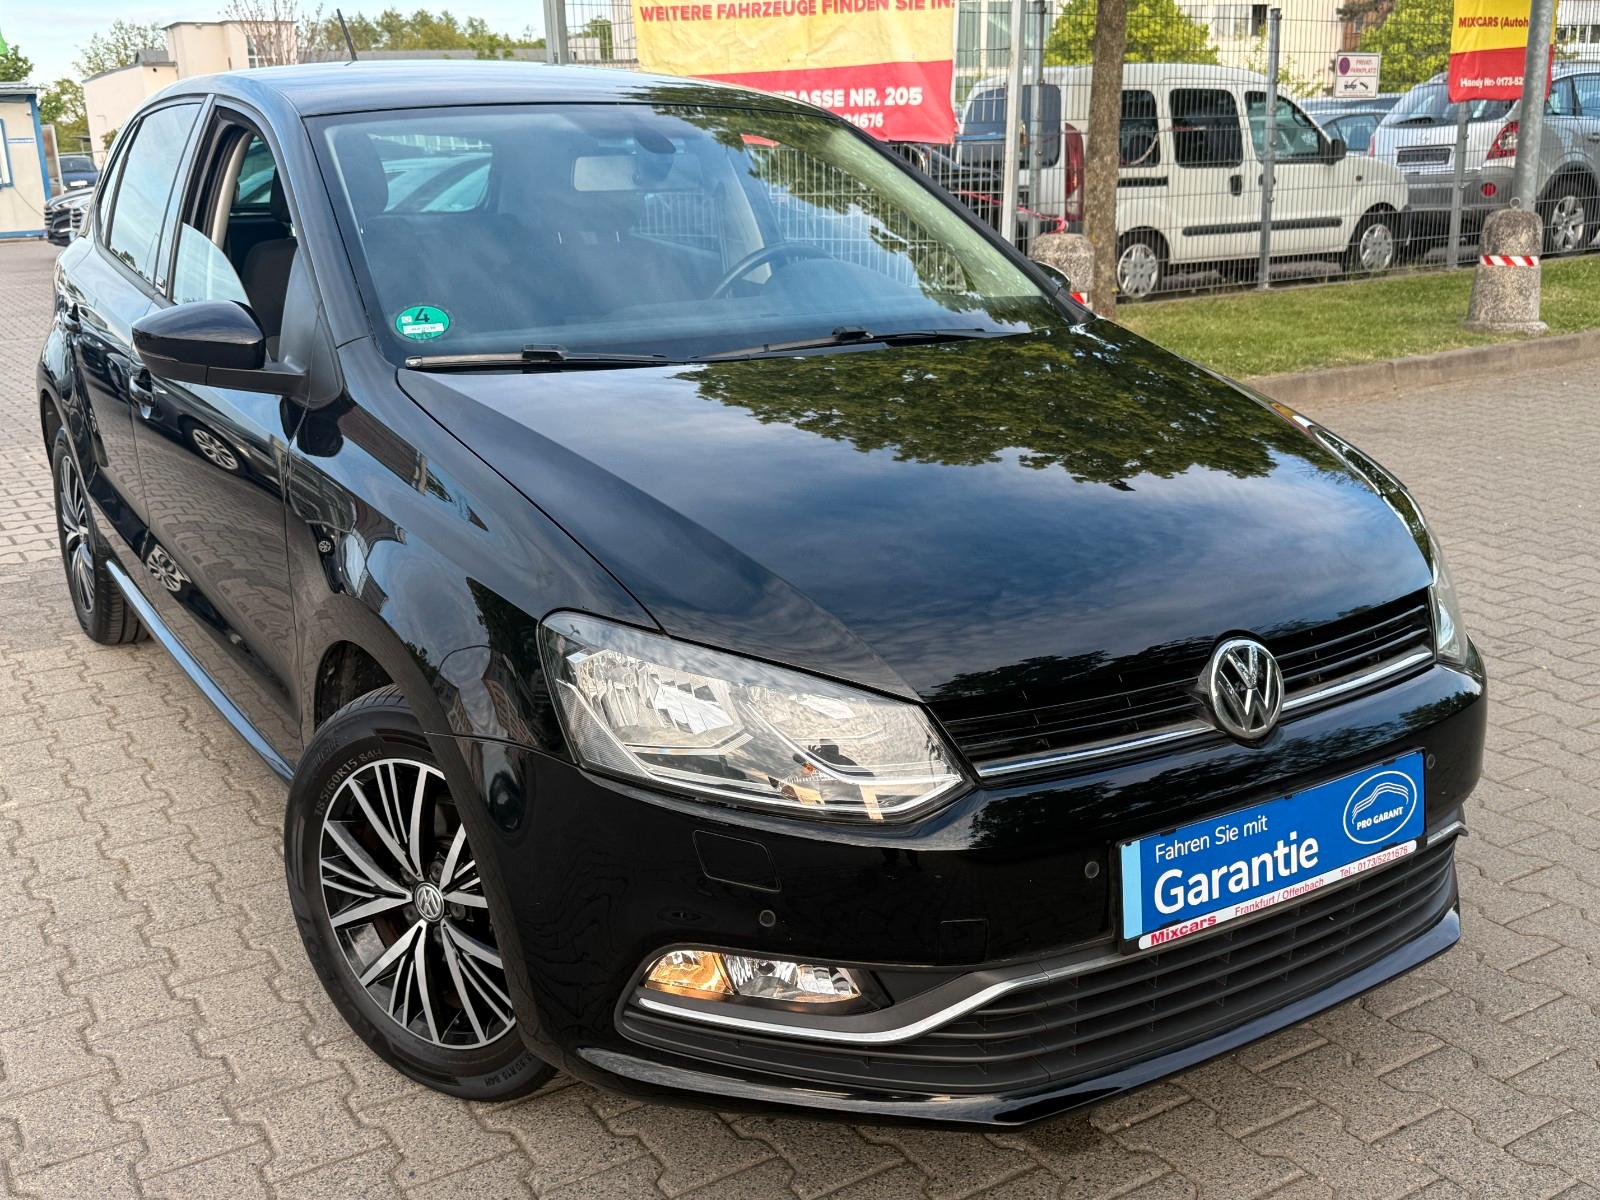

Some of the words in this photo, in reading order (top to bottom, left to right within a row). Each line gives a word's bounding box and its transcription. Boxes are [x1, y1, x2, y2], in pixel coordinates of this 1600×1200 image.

[639, 4, 713, 23] WEITERE
[717, 0, 817, 20] FAHRZEUGE
[822, 0, 889, 15] FINDEN
[895, 0, 925, 11] SIE
[1458, 16, 1499, 29] MIXCARS
[1460, 77, 1483, 89] Handy
[849, 88, 881, 107] NR.
[884, 86, 923, 106] 205
[414, 308, 430, 323] 4
[1211, 639, 1283, 739] VW
[1356, 817, 1372, 831] PRO
[1373, 806, 1404, 824] GARANT
[1155, 833, 1210, 864] Fahren
[1215, 824, 1239, 845] Sie
[1243, 814, 1268, 837] mit
[1154, 830, 1319, 914] Garantie
[1150, 915, 1217, 946] Mixcars
[1234, 895, 1275, 916] Frankfurt
[1282, 877, 1324, 900] Offenbach
[1357, 845, 1408, 872] 0173/5221676
